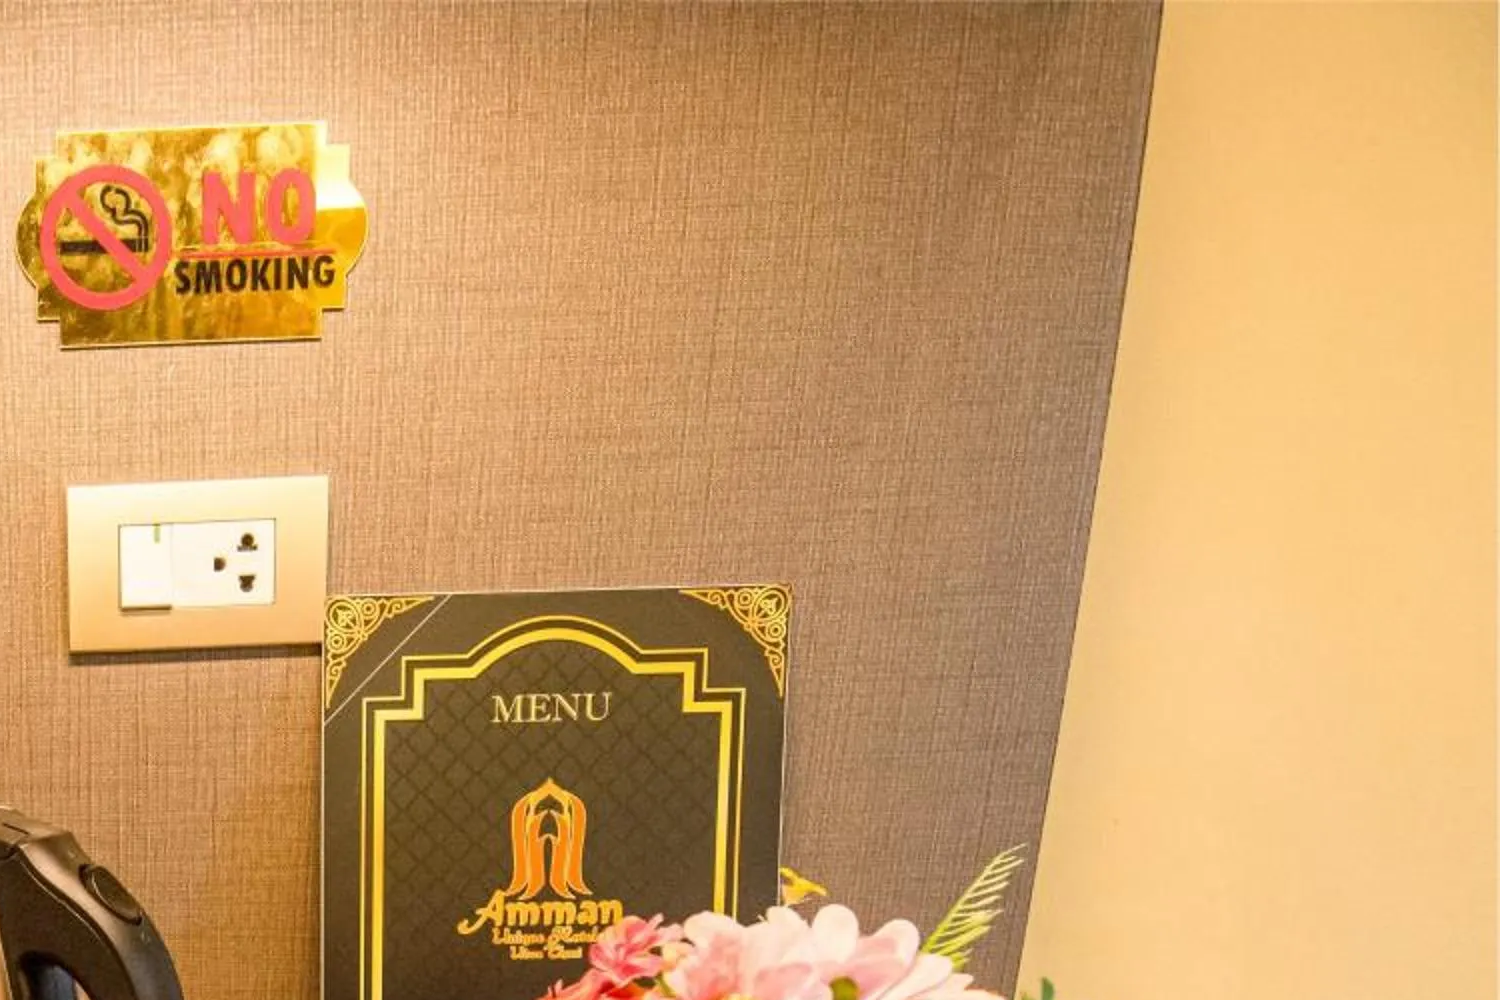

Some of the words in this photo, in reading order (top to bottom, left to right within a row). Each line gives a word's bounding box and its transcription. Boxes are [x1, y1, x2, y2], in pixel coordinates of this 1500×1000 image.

[203, 168, 317, 245] NO
[173, 254, 336, 297] SMOKING
[490, 691, 613, 725] MENU
[457, 889, 624, 935] Amman
